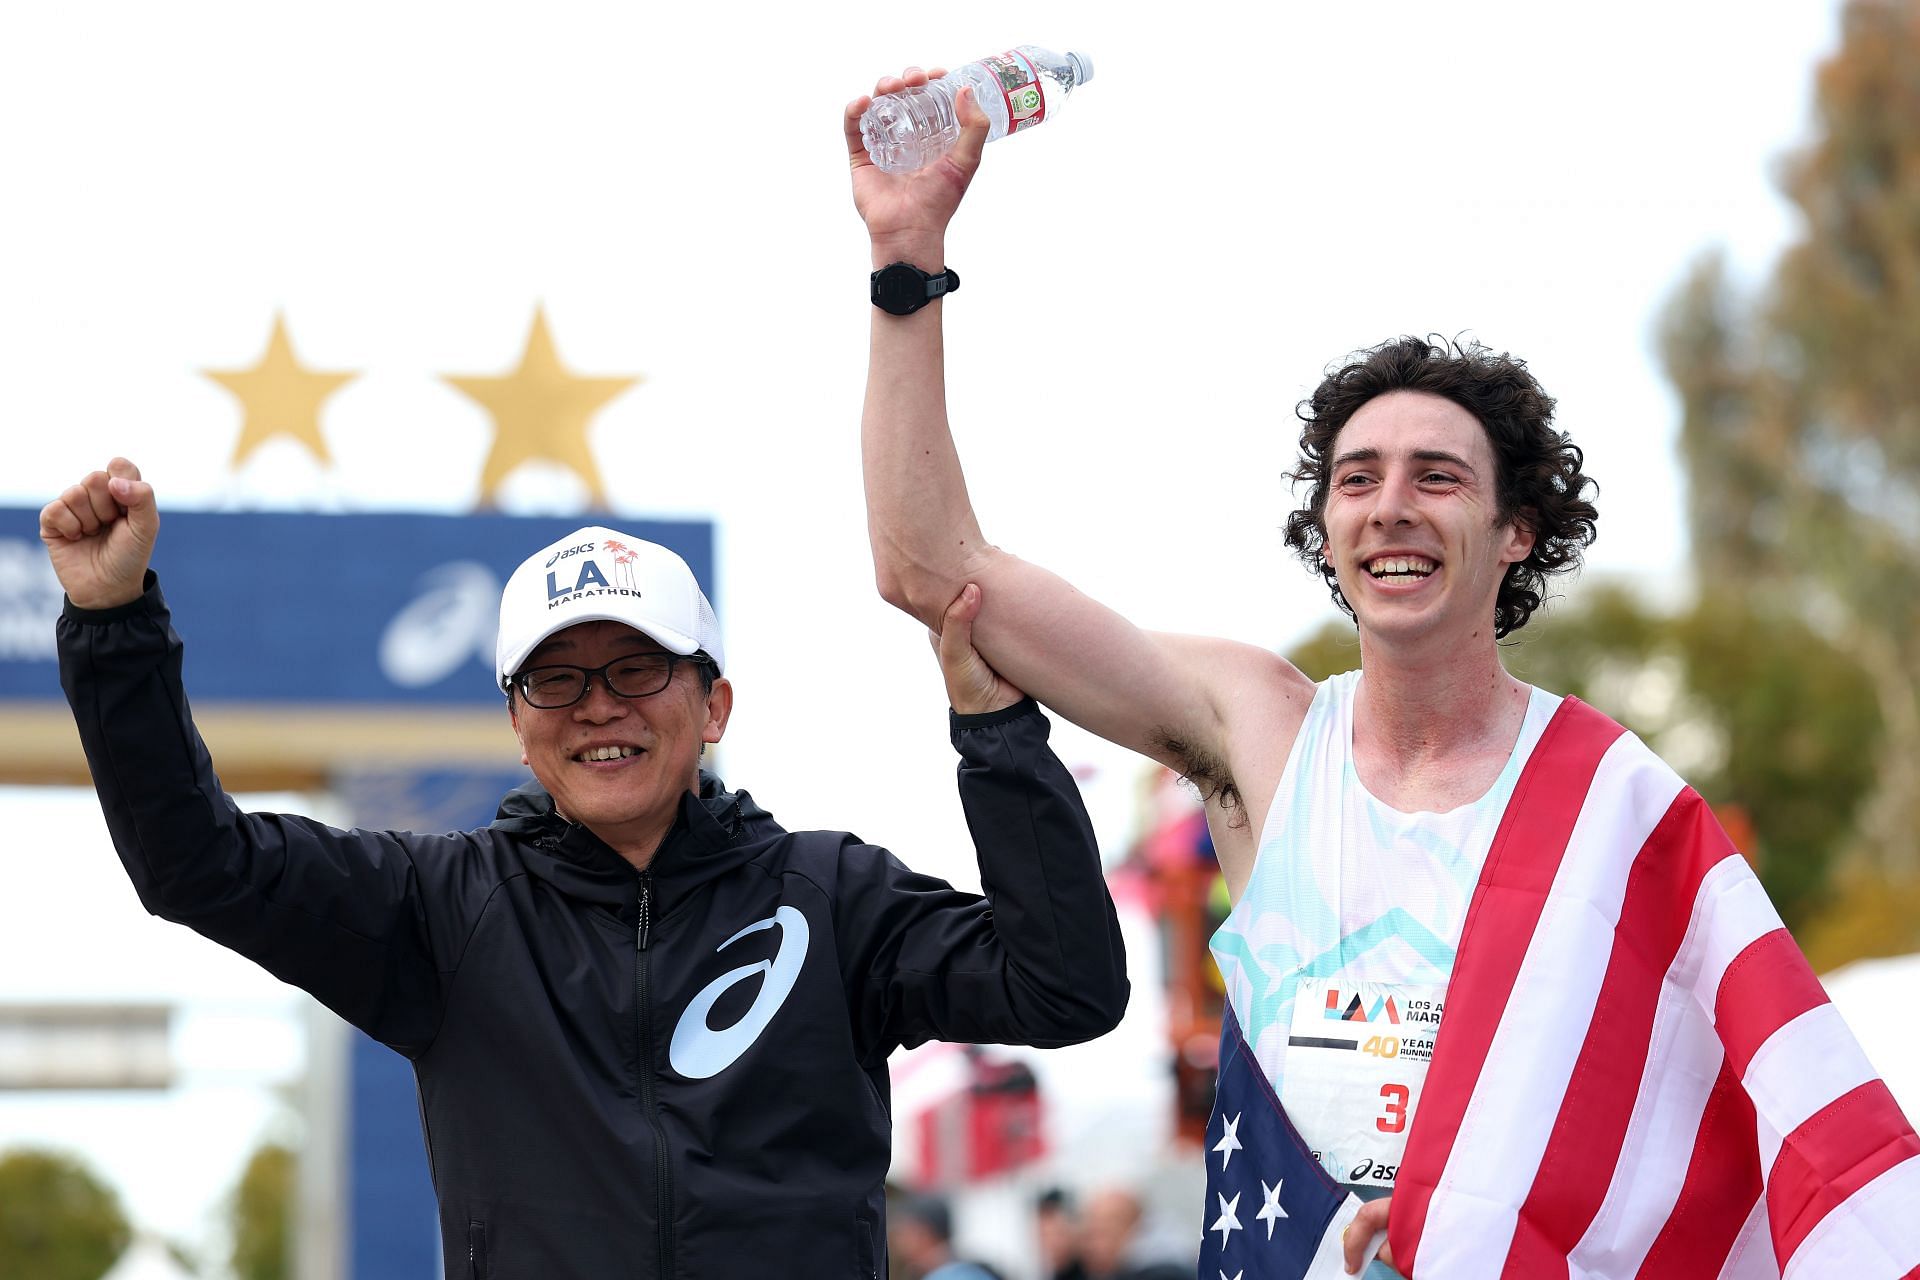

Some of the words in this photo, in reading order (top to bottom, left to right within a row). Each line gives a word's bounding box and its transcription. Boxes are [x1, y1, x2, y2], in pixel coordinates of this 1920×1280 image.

[546, 560, 610, 601] LA
[548, 588, 642, 610] MARATHON
[1408, 1000, 1431, 1010] LOS
[1406, 1010, 1440, 1025] MAR
[1362, 1035, 1399, 1059] 40
[1376, 1083, 1410, 1134] 3
